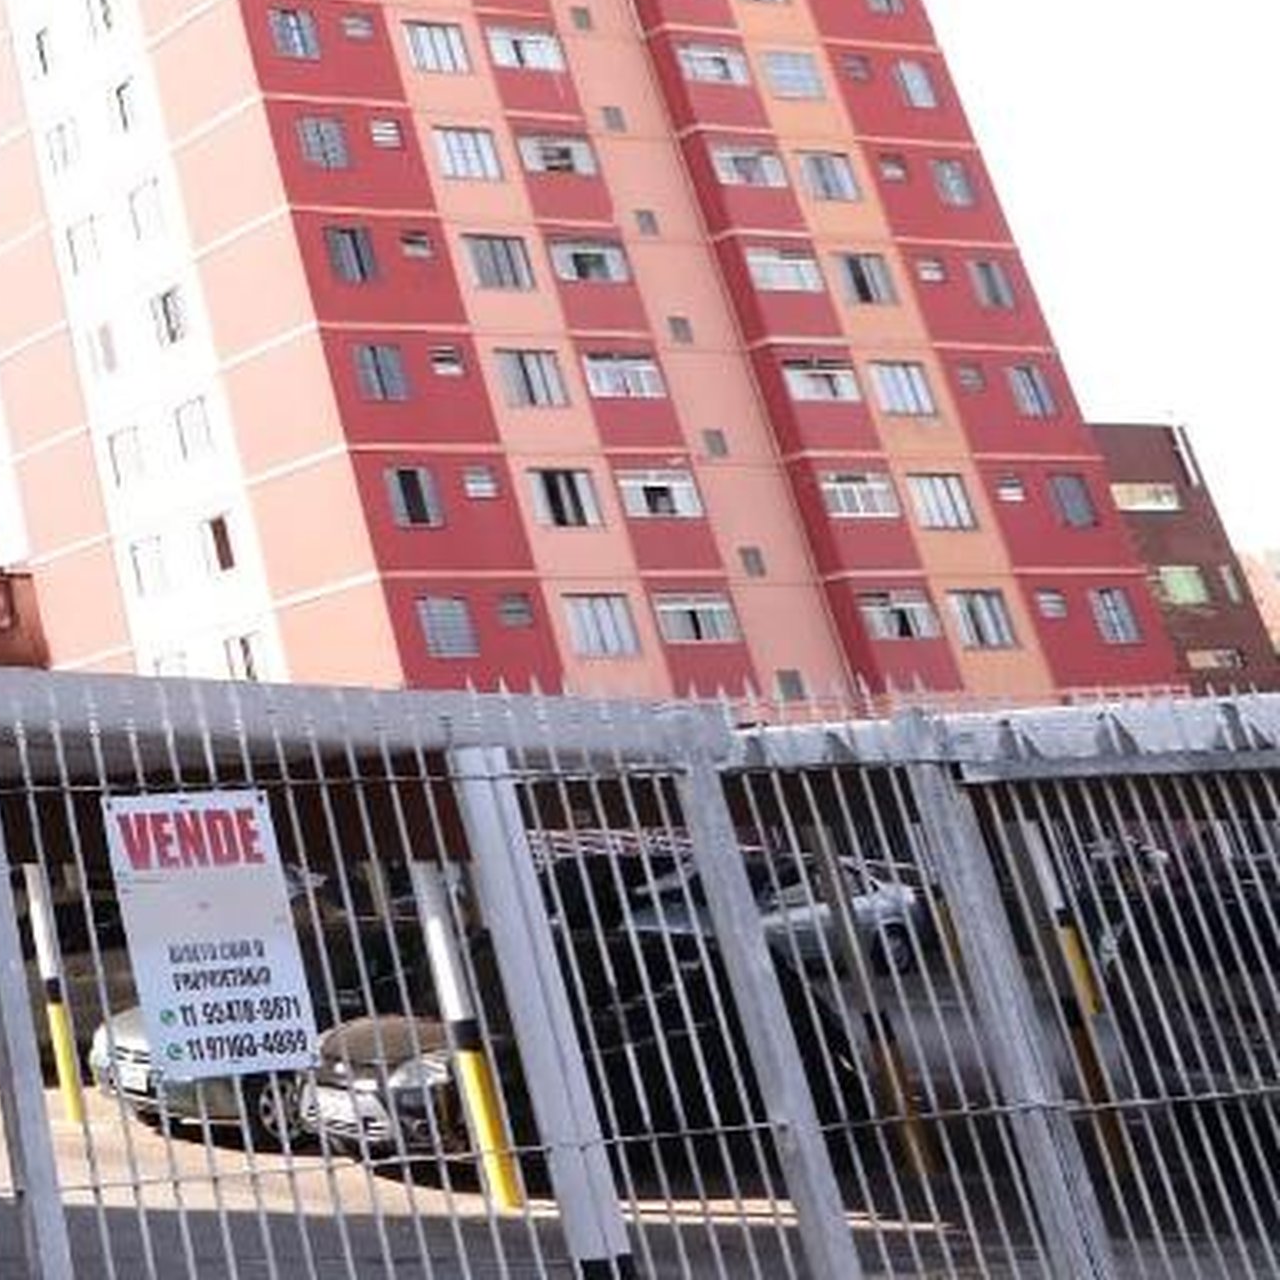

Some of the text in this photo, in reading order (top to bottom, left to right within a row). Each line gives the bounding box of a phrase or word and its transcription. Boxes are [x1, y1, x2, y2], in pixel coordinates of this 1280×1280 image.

[117, 807, 266, 870] VENDE
[180, 1003, 197, 1027] 11
[186, 1038, 204, 1061] 11
